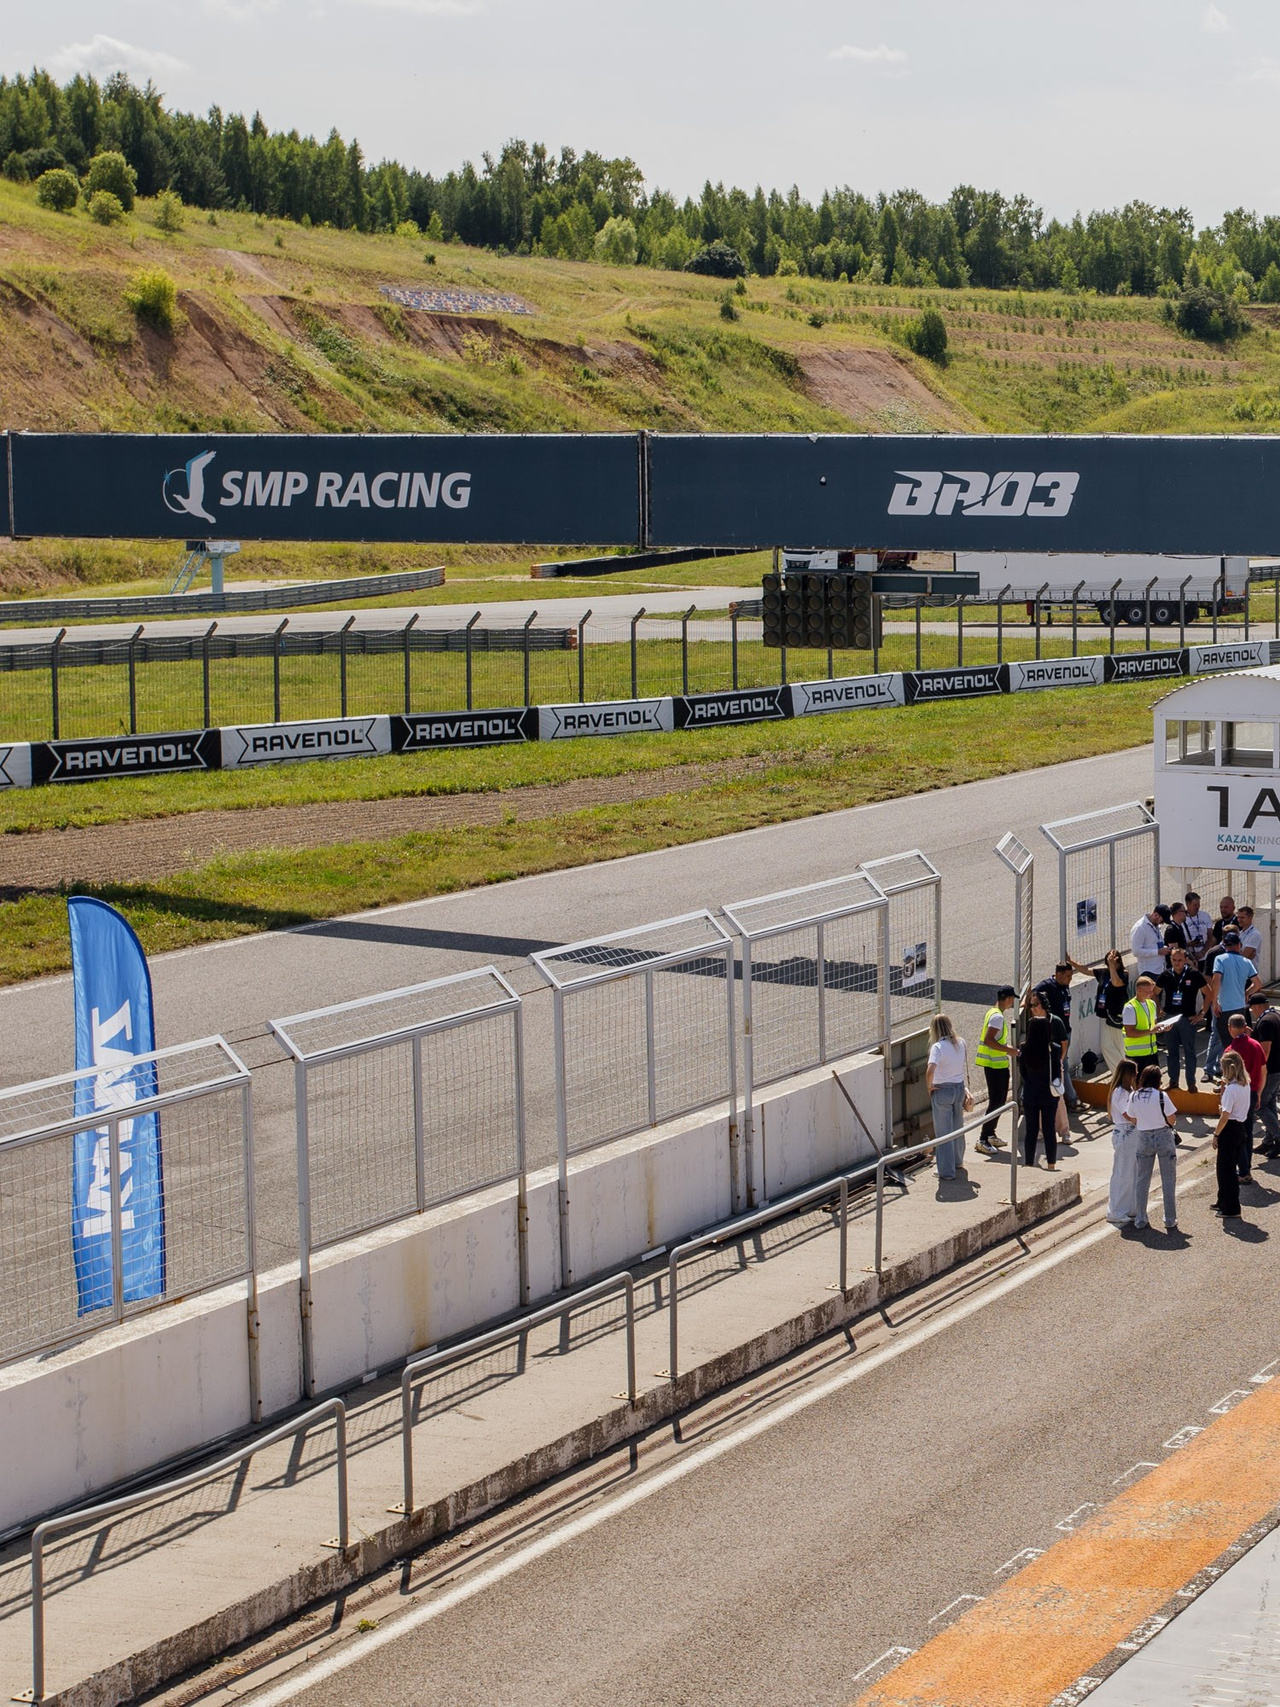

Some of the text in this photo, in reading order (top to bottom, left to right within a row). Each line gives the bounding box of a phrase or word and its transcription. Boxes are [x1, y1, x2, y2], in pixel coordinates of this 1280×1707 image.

[220, 470, 472, 509] SMP RACING
[1118, 655, 1175, 674] RAVENOL
[1202, 648, 1257, 665] RAVENOL
[921, 674, 996, 692] RAVENOL
[1026, 666, 1088, 682] RAVENOL
[811, 684, 886, 705] RAVENOL
[694, 698, 773, 720] RAVENOL
[415, 717, 515, 740] RAVENOL
[563, 710, 652, 731] RAVENOL
[252, 730, 362, 752] RAVENOL
[65, 744, 188, 769] RAVENOL
[1217, 843, 1255, 853] CANYON
